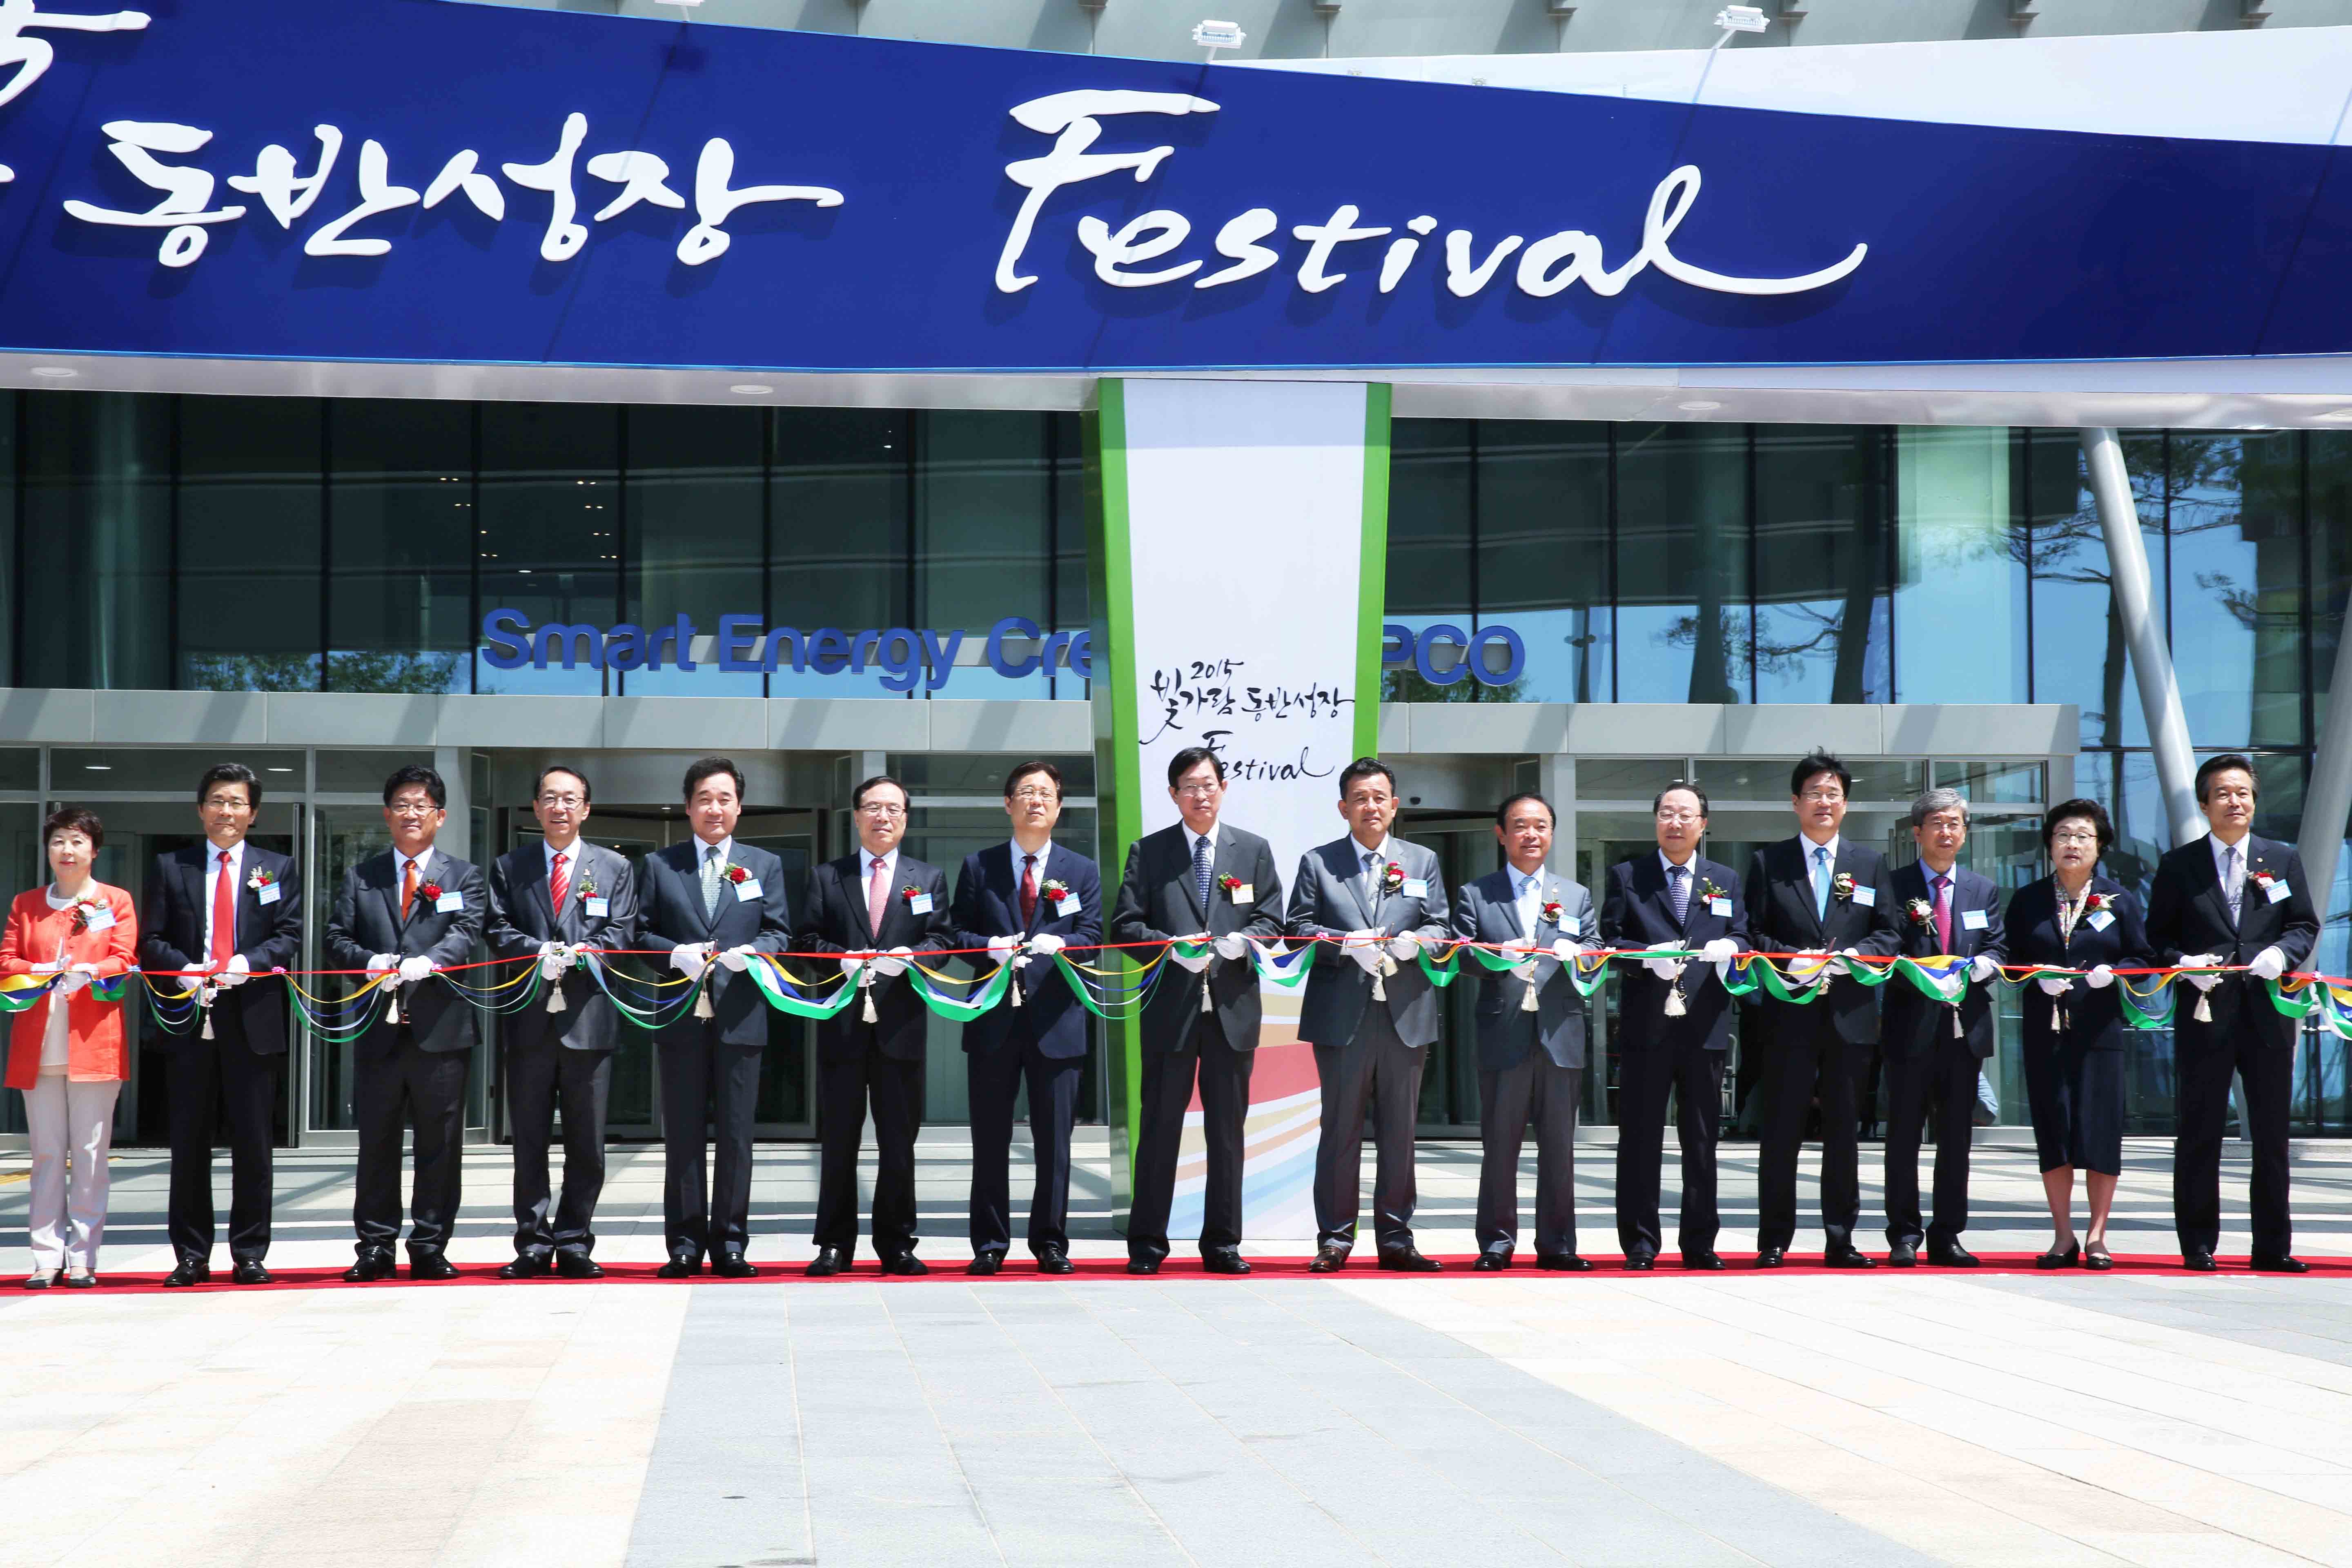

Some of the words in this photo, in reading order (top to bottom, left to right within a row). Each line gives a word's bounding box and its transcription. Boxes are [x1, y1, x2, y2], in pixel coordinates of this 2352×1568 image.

[63, 112, 844, 268] 동반성장
[995, 89, 1869, 298] Festival
[481, 608, 697, 671] Smart
[718, 613, 964, 692] Energy
[1191, 658, 1245, 687] 2015
[1138, 668, 1236, 745] 빛가람
[1241, 682, 1356, 722] 동반성장
